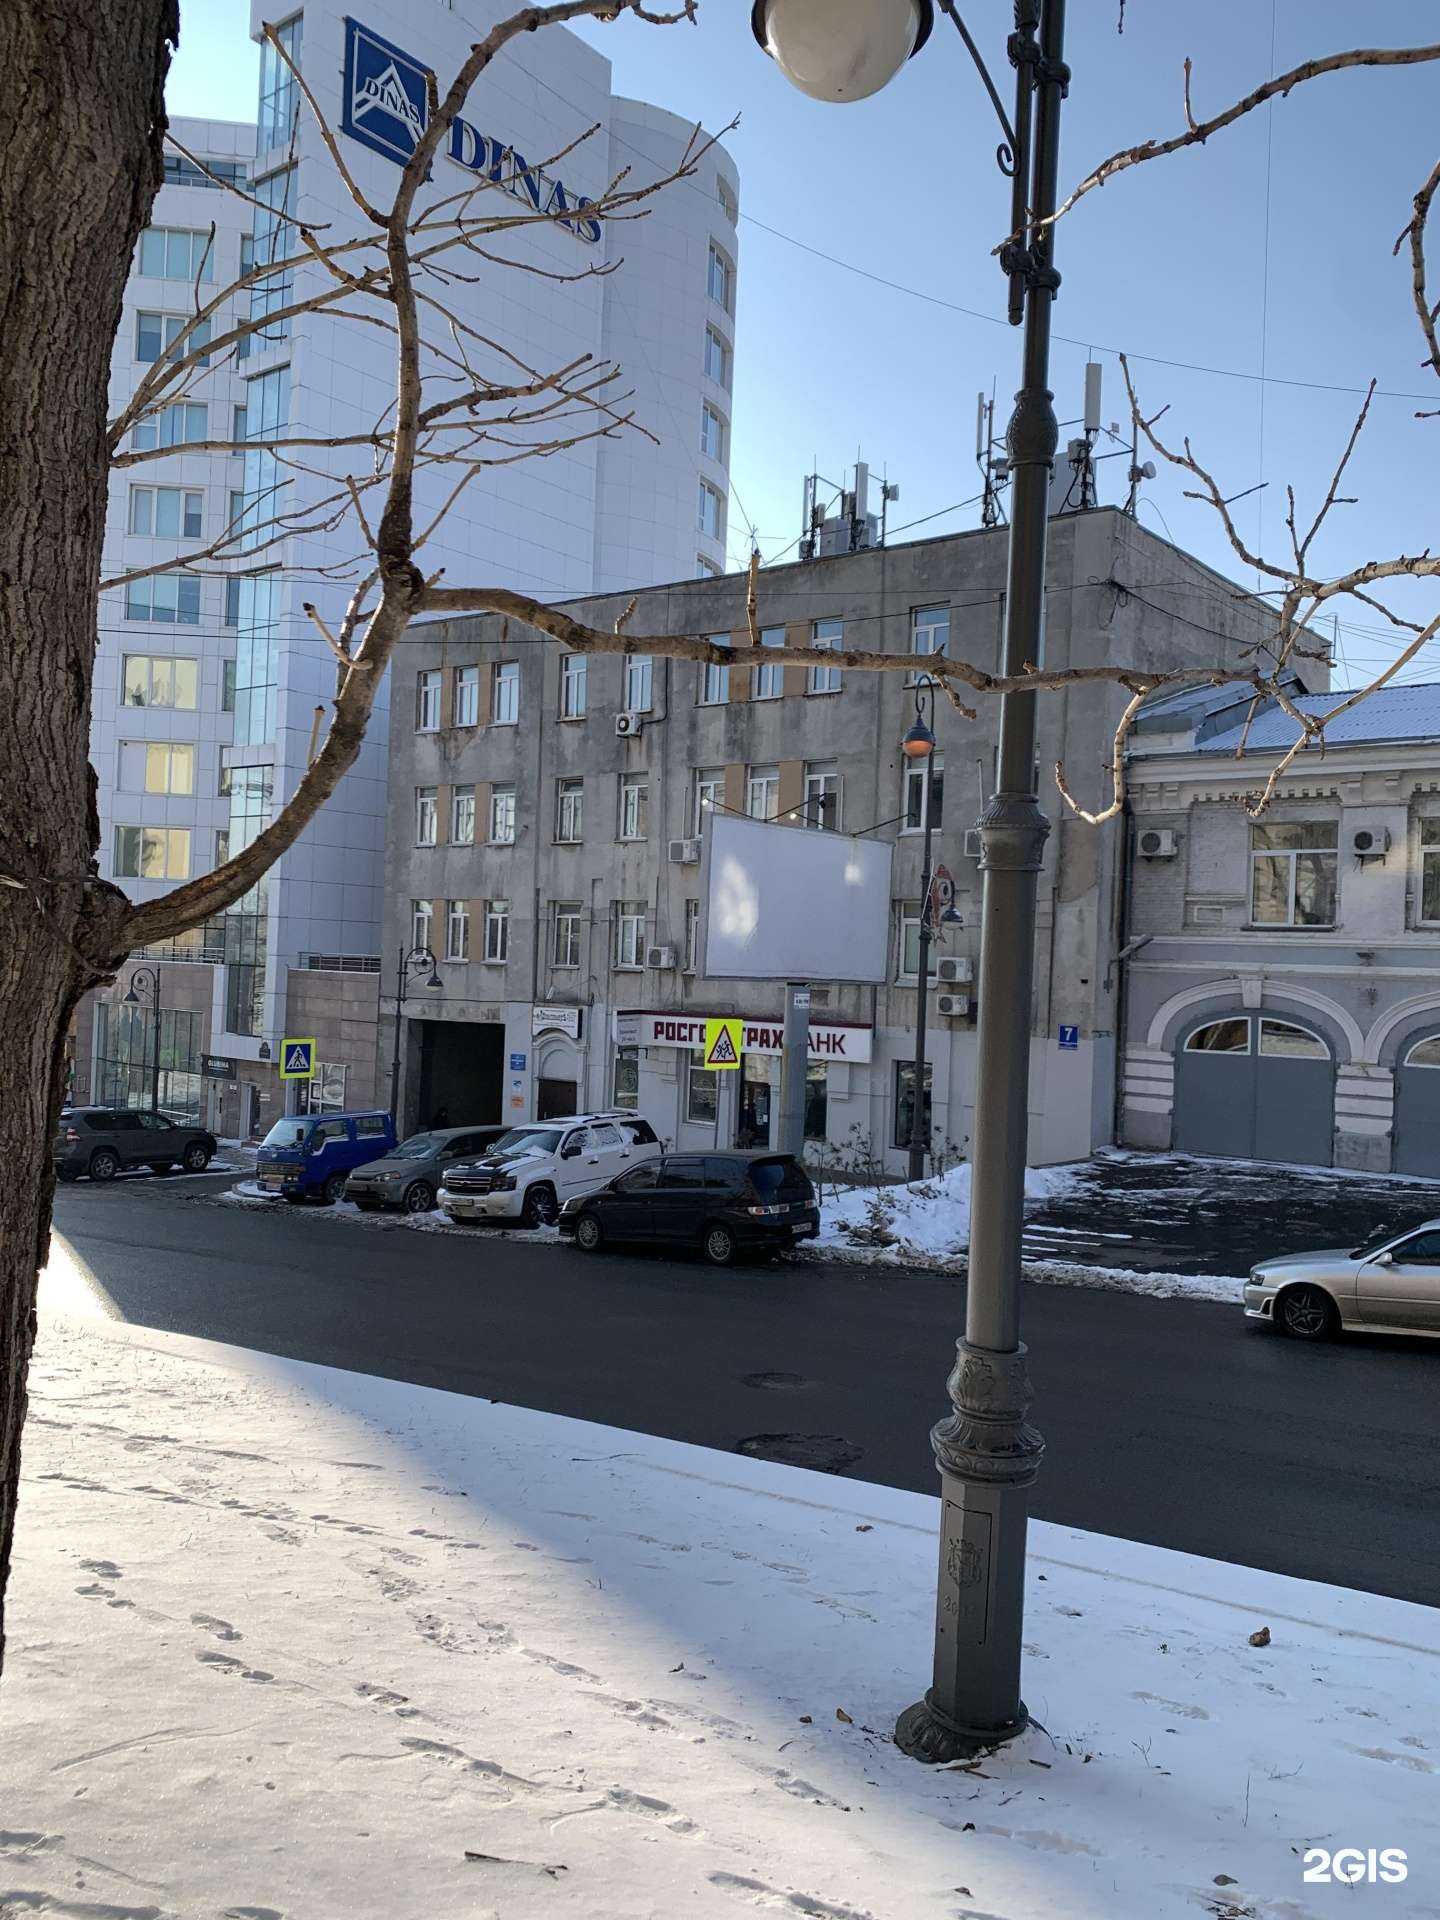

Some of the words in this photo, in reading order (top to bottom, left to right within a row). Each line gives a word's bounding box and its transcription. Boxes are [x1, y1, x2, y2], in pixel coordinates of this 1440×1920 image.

[365, 79, 420, 123] DINAS
[447, 115, 601, 242] DINAS
[654, 1021, 784, 1050] РОСГОРАХ
[1064, 1027, 1073, 1041] 7
